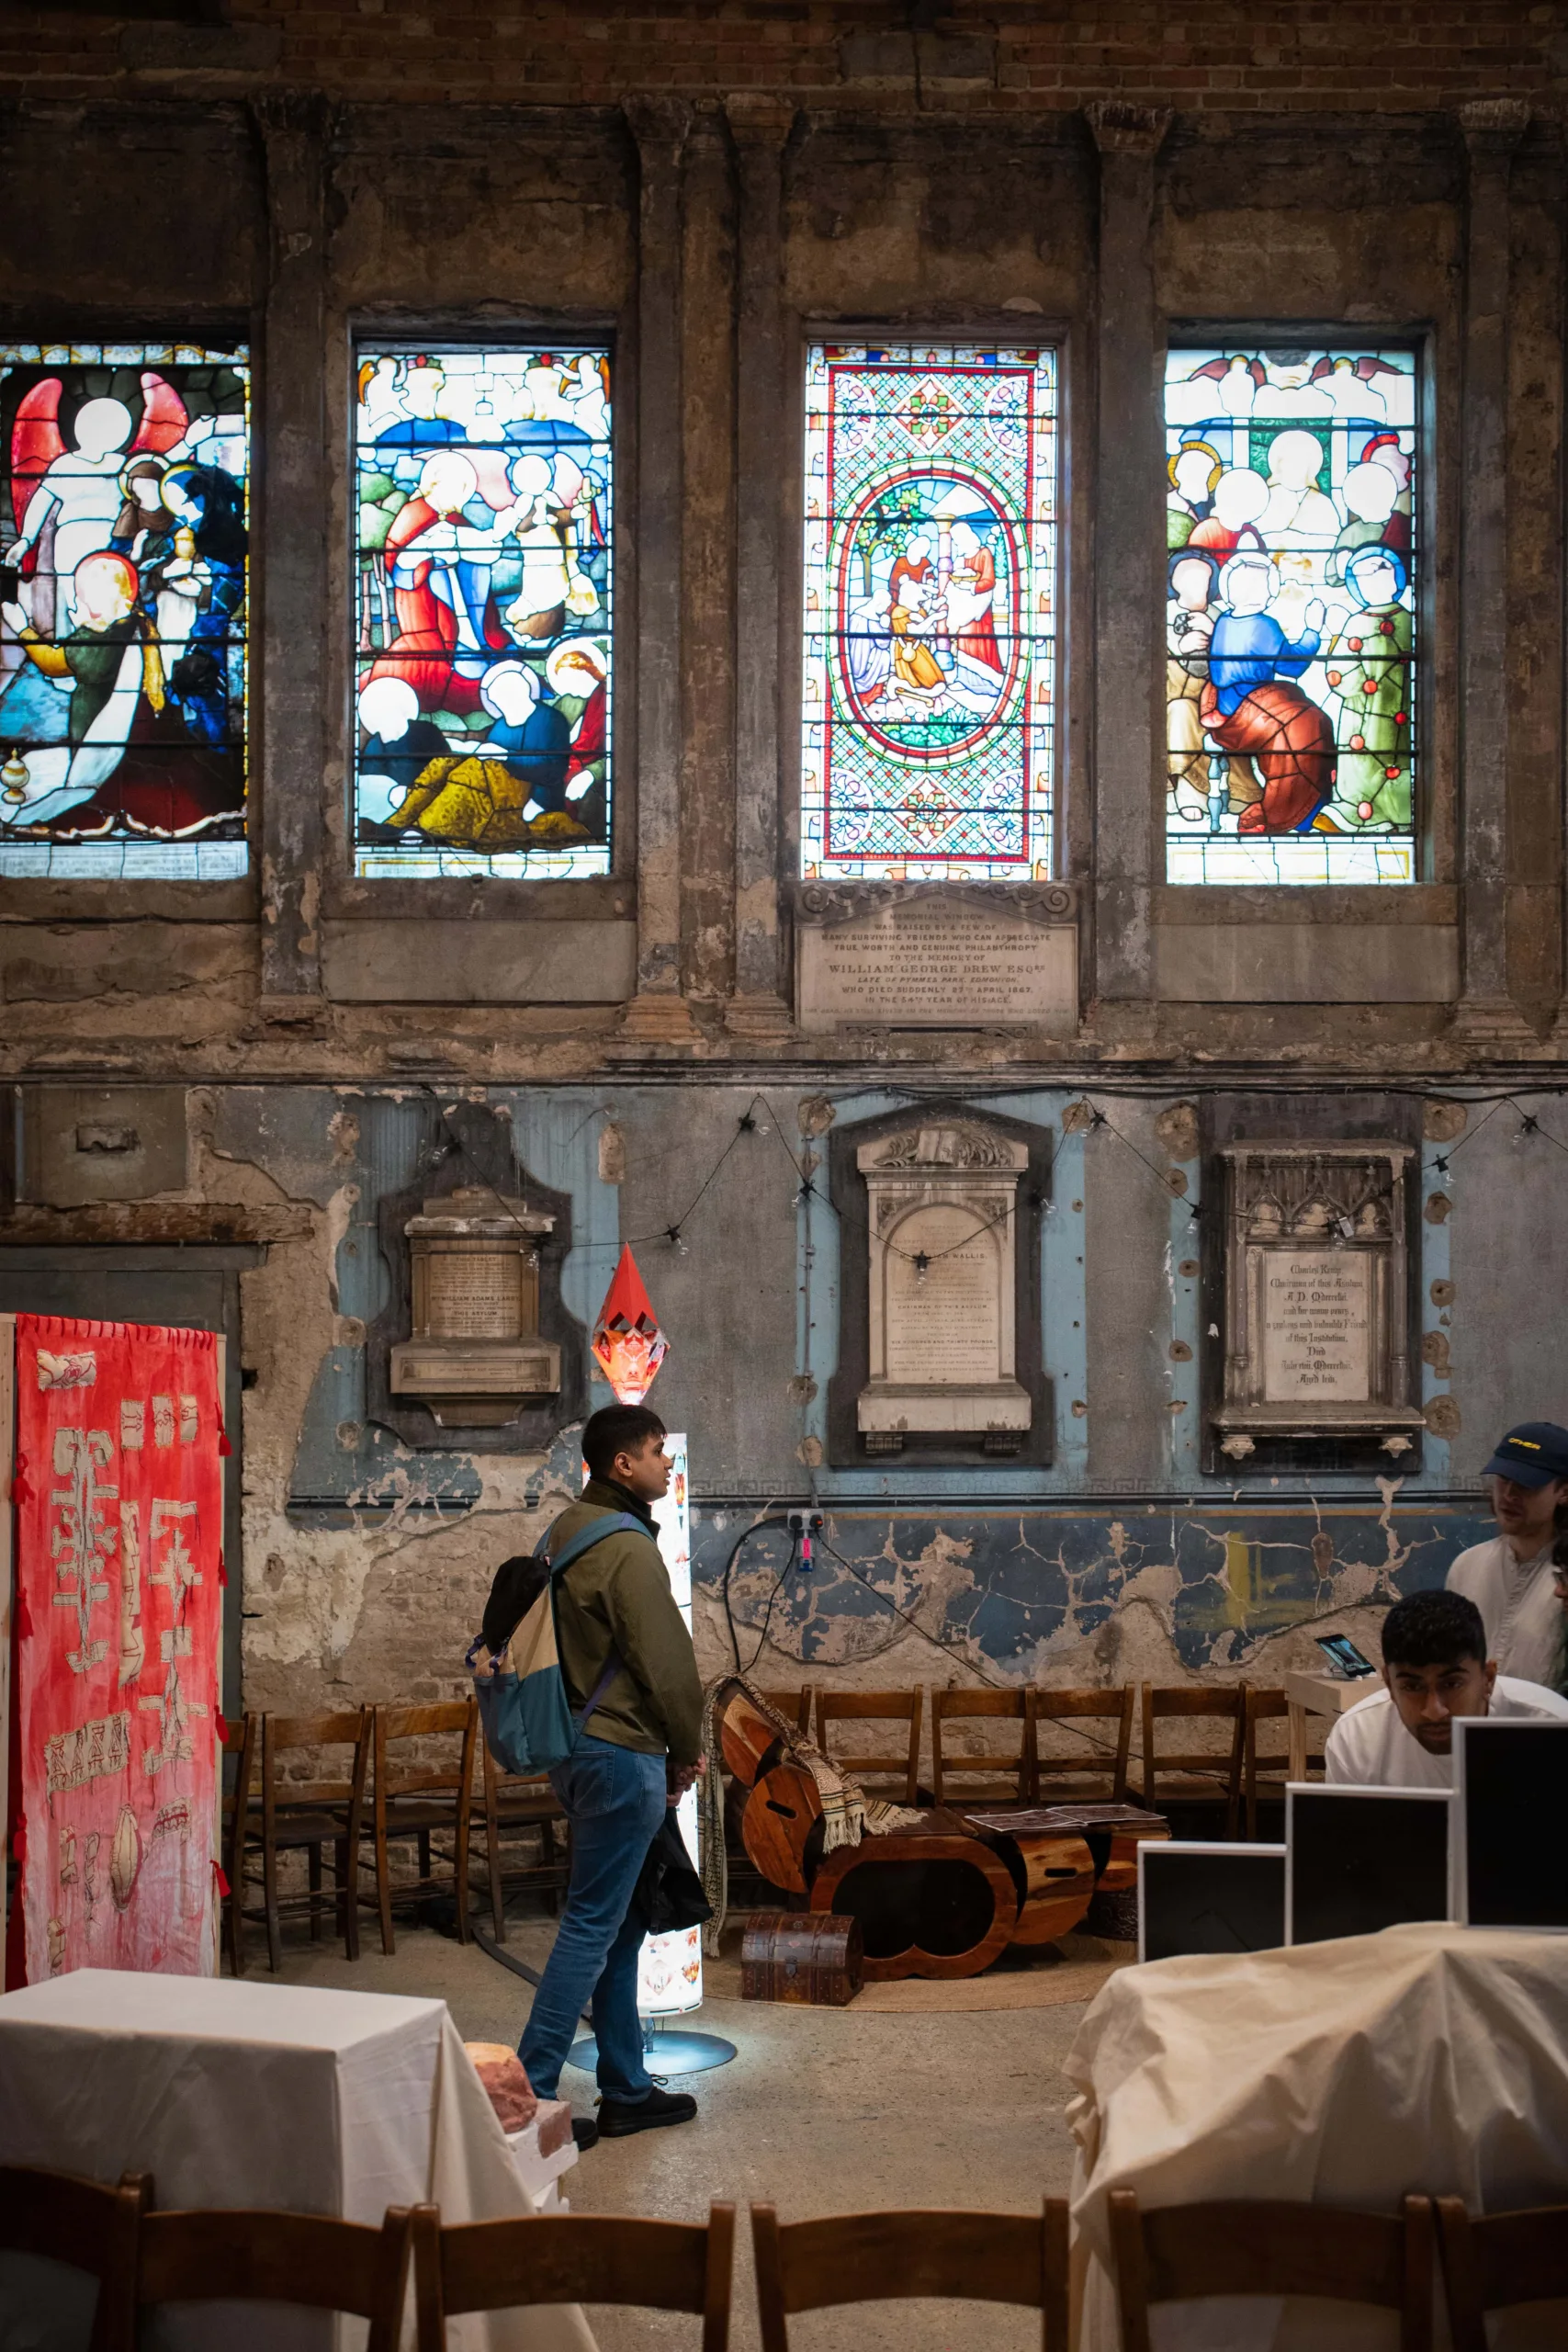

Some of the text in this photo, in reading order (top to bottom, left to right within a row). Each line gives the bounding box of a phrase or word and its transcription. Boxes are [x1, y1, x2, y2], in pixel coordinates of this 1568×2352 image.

[834, 944, 1037, 952] TRUE WORTH AND GENUINE PHILANTHROPY
[889, 954, 986, 962] TO THE MEMORY OF
[829, 964, 894, 974] WILLIAM
[900, 964, 957, 974] GEORGE
[963, 964, 1001, 974] DREW
[841, 986, 864, 994] WHO
[868, 986, 893, 994] DIED
[897, 986, 946, 994] SUDDENLY
[976, 986, 1005, 994] APRIL
